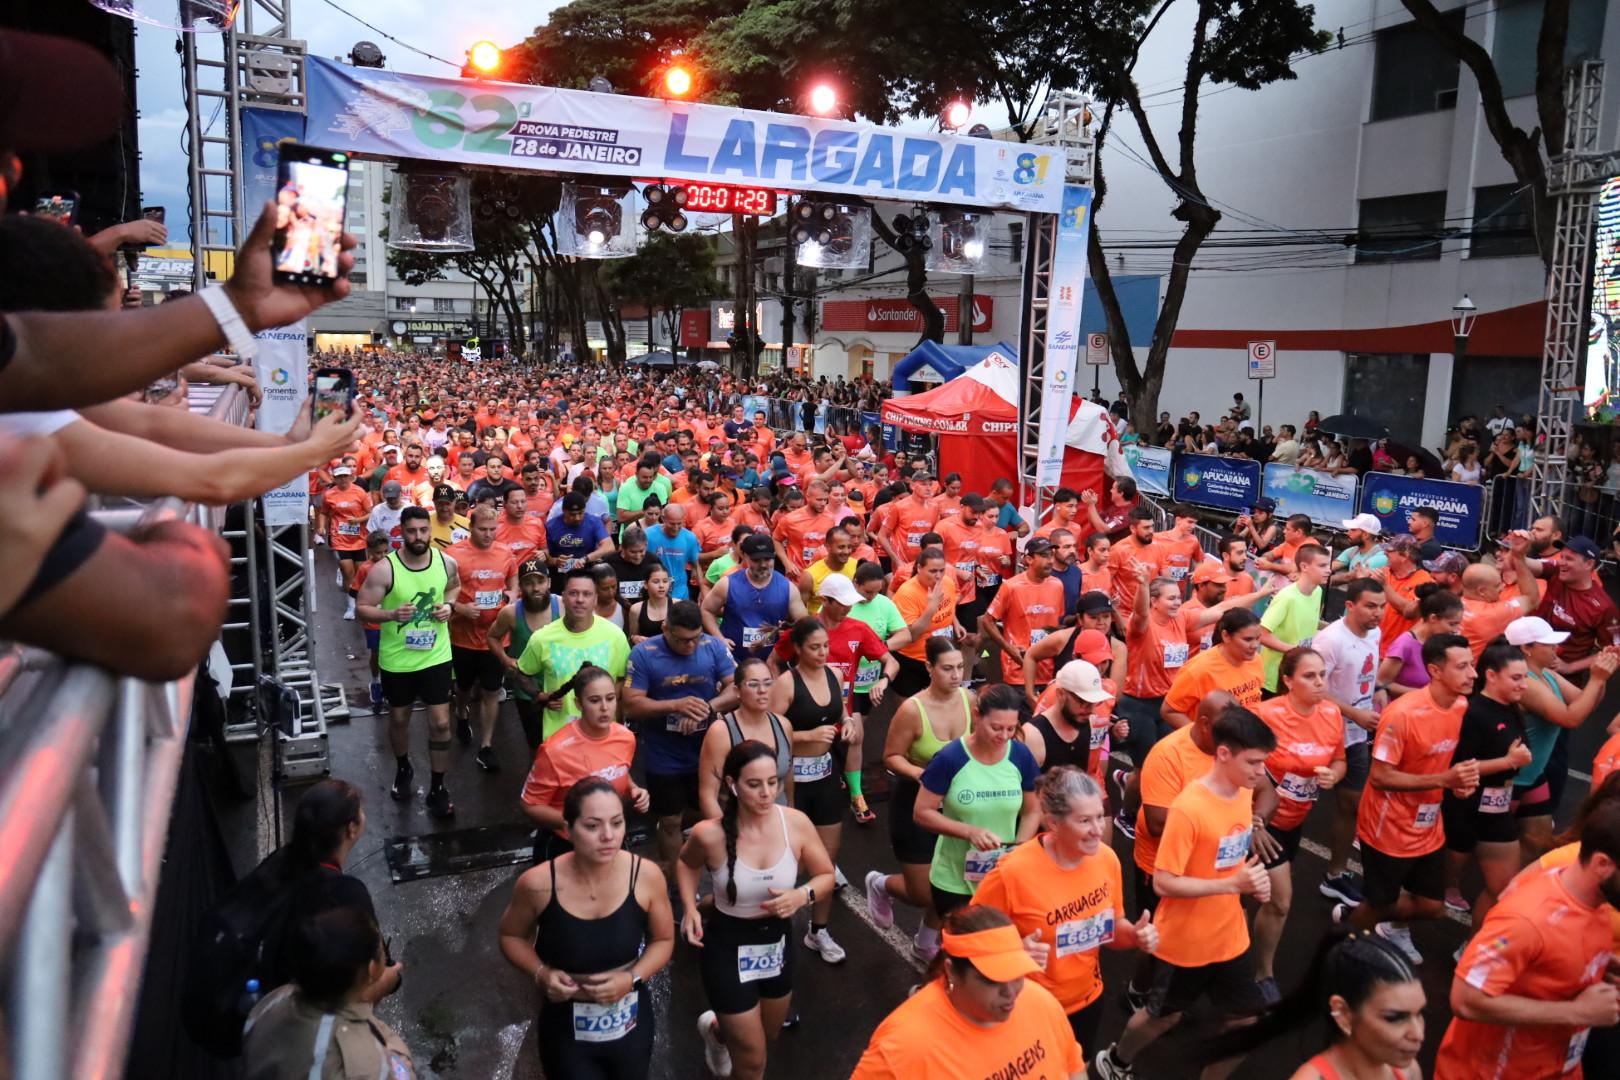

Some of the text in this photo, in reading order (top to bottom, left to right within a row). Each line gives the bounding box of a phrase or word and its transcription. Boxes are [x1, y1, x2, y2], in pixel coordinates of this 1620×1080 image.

[519, 123, 616, 142] PROVA PEDESTRE
[515, 139, 640, 164] 28 de JANEIRO
[664, 112, 976, 197] LARGADA
[1013, 152, 1051, 186] 81
[877, 308, 918, 321] Santander
[253, 332, 305, 341] SANEPAR
[1095, 336, 1101, 346] E
[1258, 346, 1265, 356] E
[264, 386, 298, 395] Fomento
[1202, 471, 1251, 486] APUCARANA
[1399, 495, 1469, 515] APUCARANA
[587, 1010, 632, 1031] 7033
